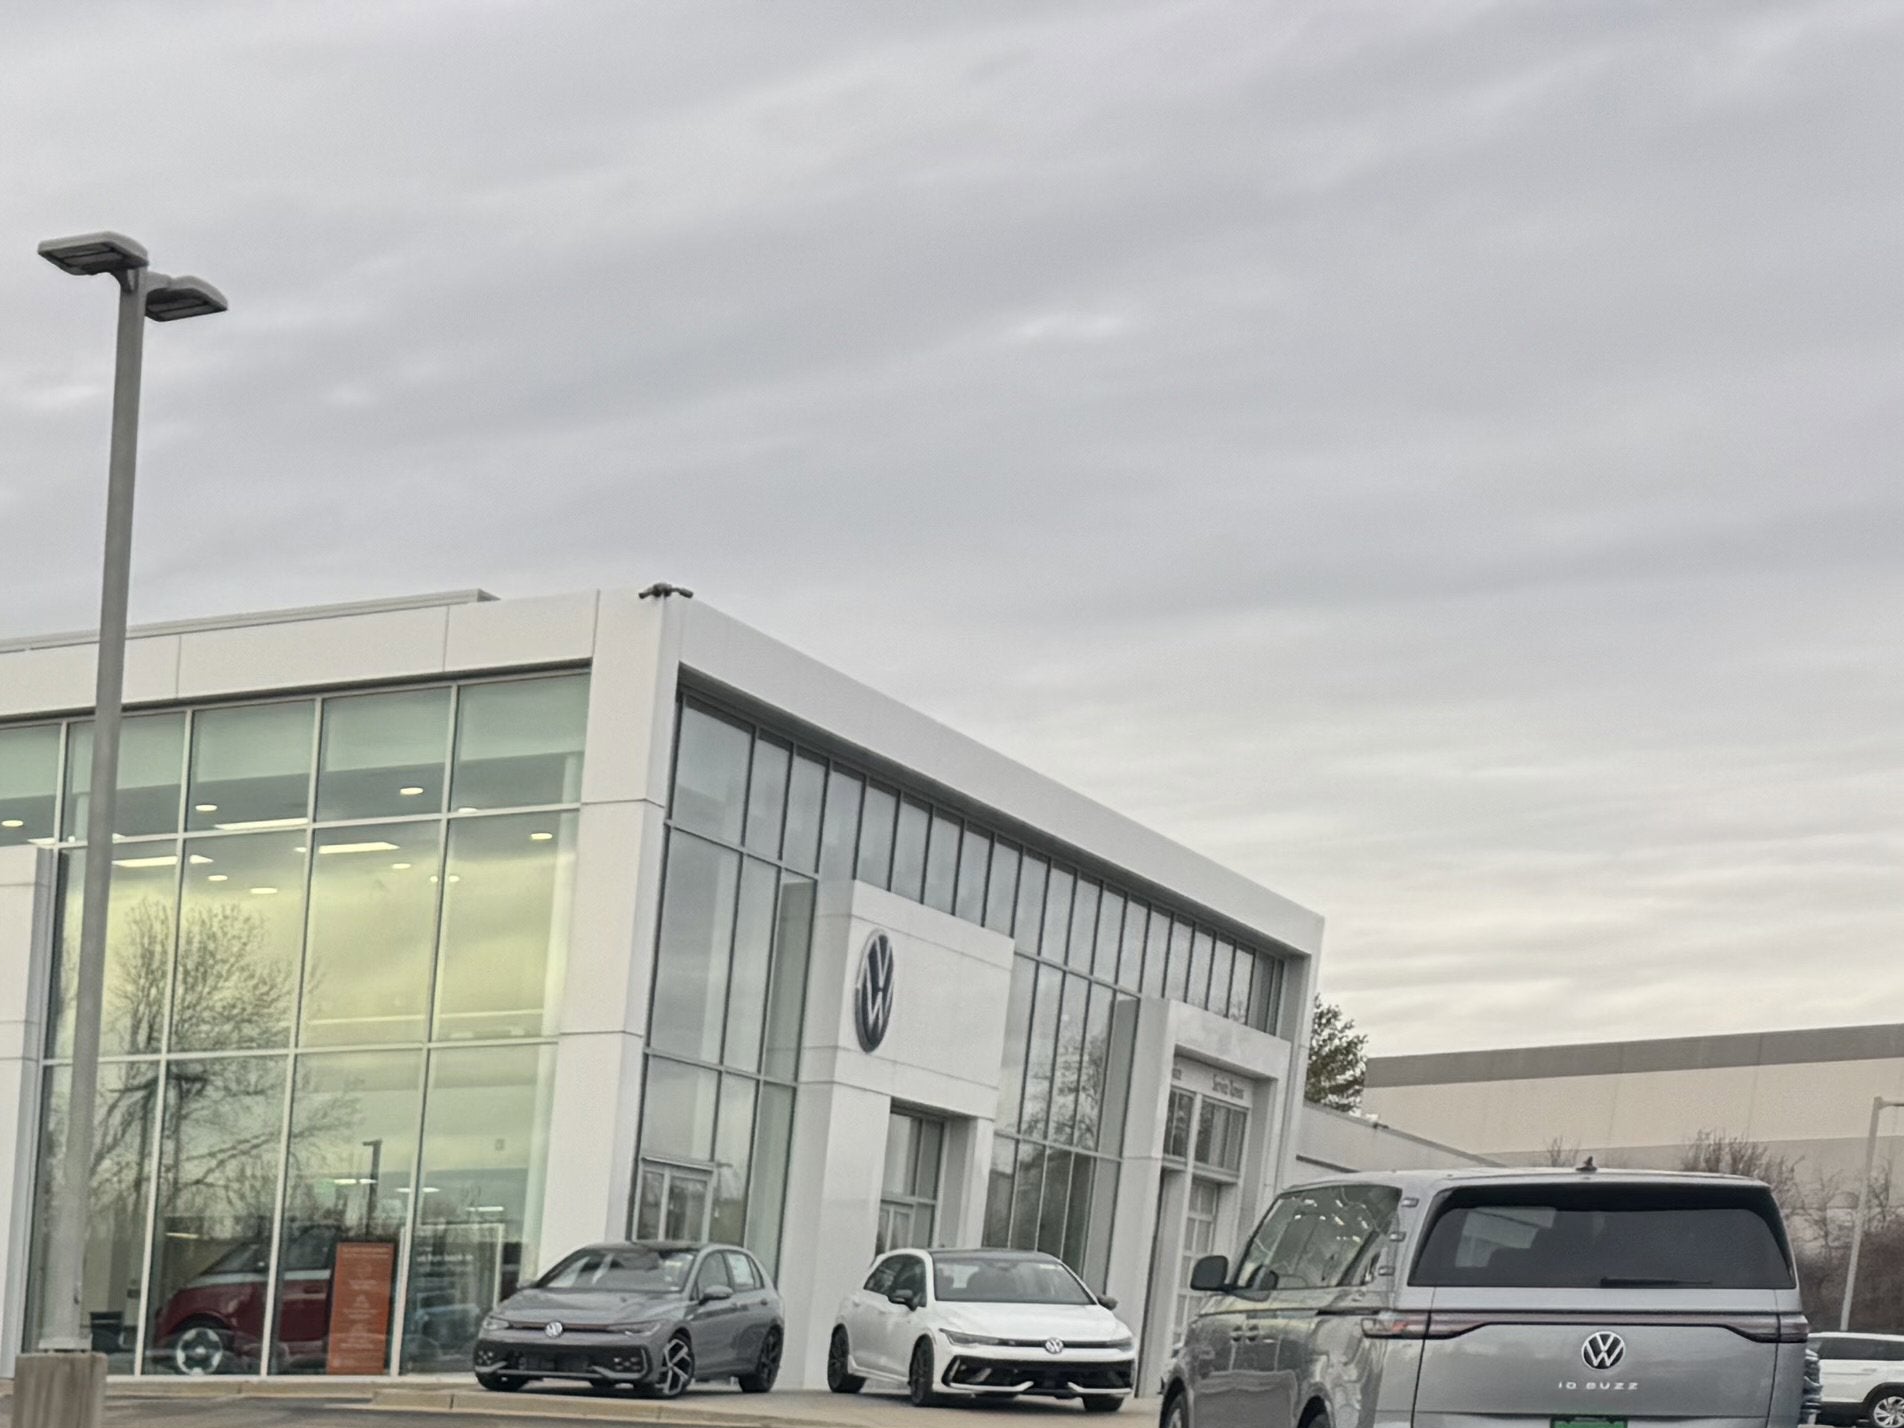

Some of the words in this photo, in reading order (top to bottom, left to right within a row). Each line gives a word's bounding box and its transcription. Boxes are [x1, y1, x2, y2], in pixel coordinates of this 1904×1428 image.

[855, 928, 894, 1054] VW
[1581, 1330, 1626, 1370] VW
[1586, 1381, 1639, 1391] BUZZ
